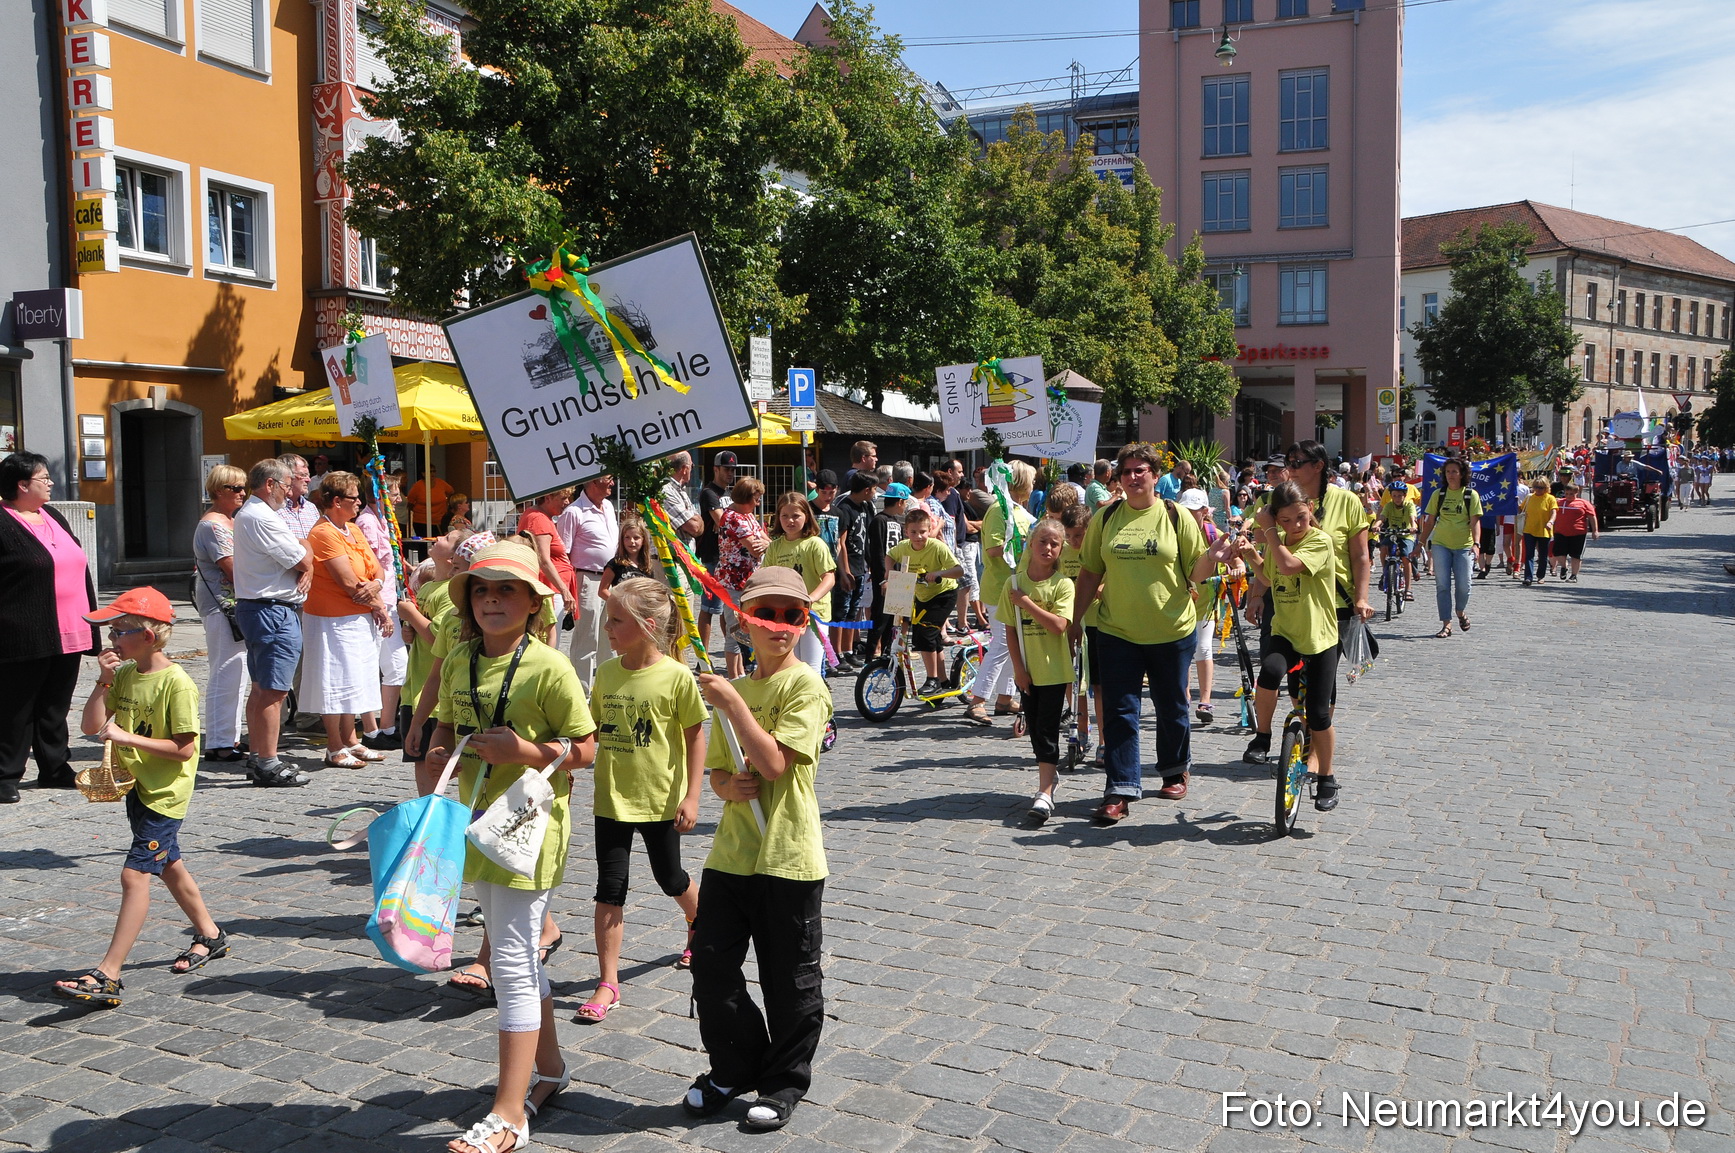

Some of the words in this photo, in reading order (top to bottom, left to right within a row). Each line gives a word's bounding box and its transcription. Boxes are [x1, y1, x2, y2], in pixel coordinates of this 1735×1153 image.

[75, 202, 103, 225] café
[77, 245, 105, 268] plank
[16, 302, 63, 328] liberty
[1236, 343, 1330, 364] Sparkasse
[794, 373, 809, 402] P
[944, 372, 960, 415] SINUS
[353, 399, 370, 409] Bildung
[369, 396, 382, 405] durch
[373, 407, 383, 415] und
[382, 403, 398, 413] Schrift
[257, 420, 284, 430] Bäckerei
[291, 418, 305, 427] Café
[1071, 407, 1083, 428] EUROPA
[957, 436, 968, 445] Wir
[999, 429, 1043, 440] USSCHULE
[1032, 443, 1047, 456] ONALE
[603, 702, 625, 710] olzheim
[604, 745, 635, 754] weltschule
